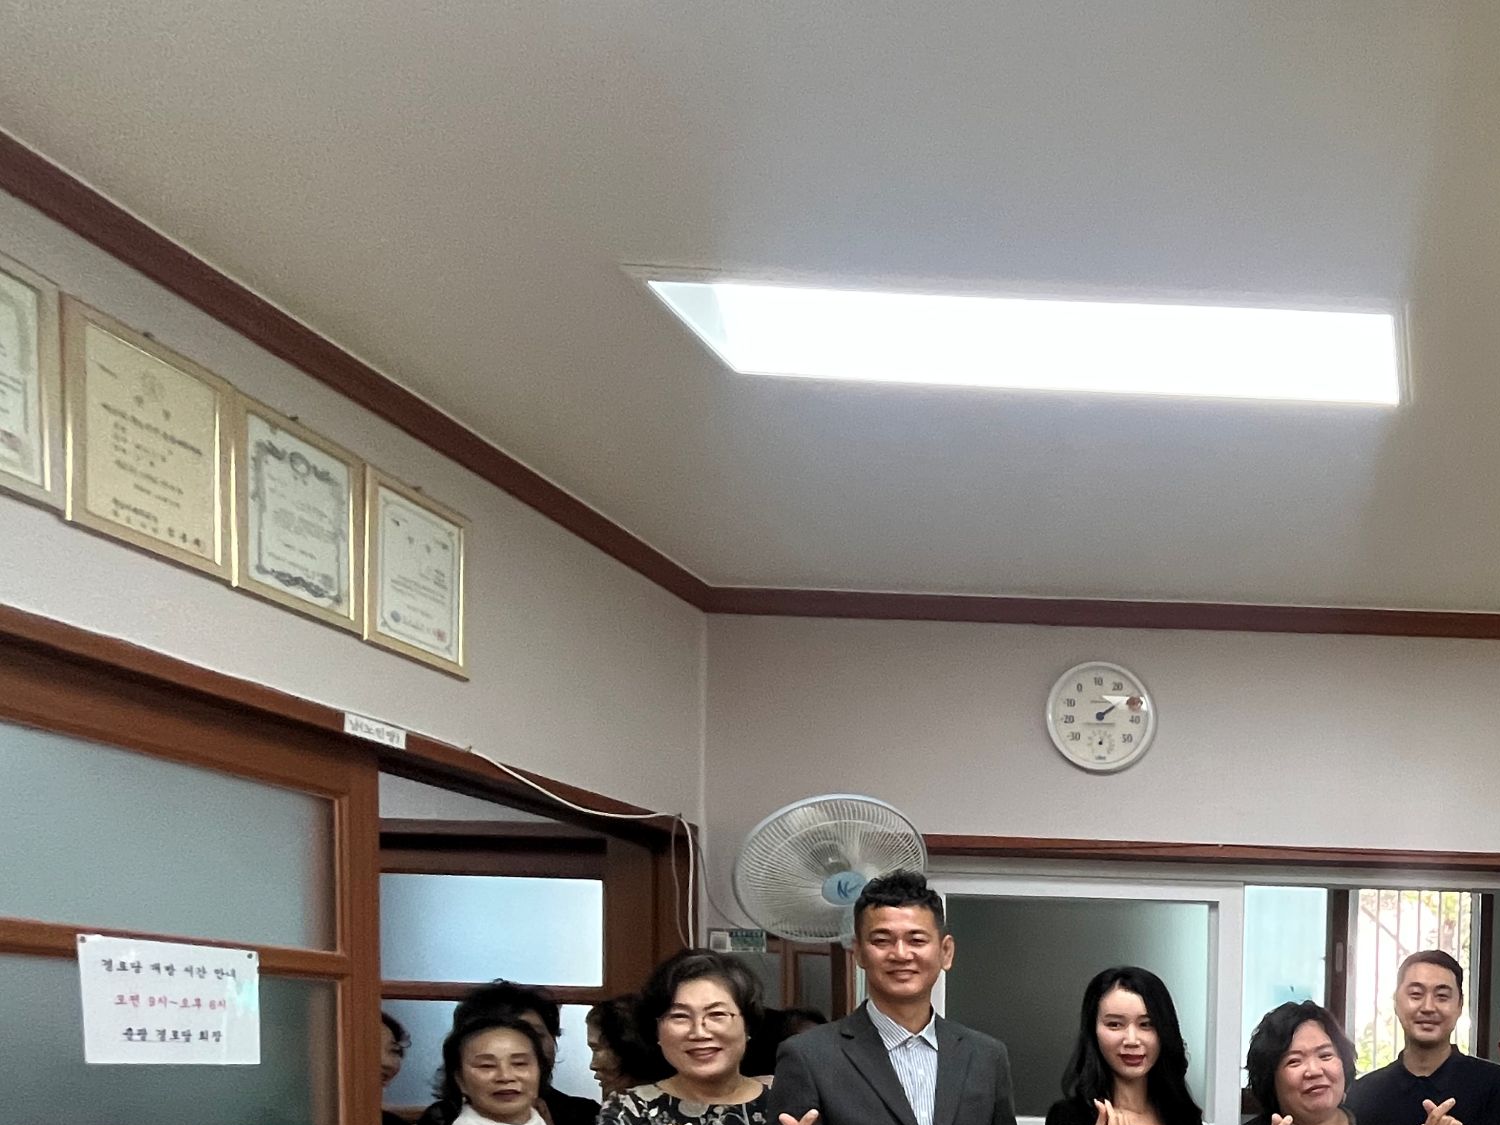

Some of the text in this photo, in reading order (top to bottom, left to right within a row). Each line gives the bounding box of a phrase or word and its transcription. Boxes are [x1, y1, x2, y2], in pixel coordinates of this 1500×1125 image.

[1094, 677, 1103, 686] 10
[1077, 683, 1082, 692] 0
[1112, 682, 1123, 691] 20
[1129, 716, 1140, 724] 40
[1122, 734, 1133, 743] 50
[101, 958, 143, 974] 경로당
[183, 964, 207, 980] 시간
[114, 994, 140, 1009] 오전
[156, 1028, 192, 1043] 경로당
[198, 1030, 223, 1043] 회장
